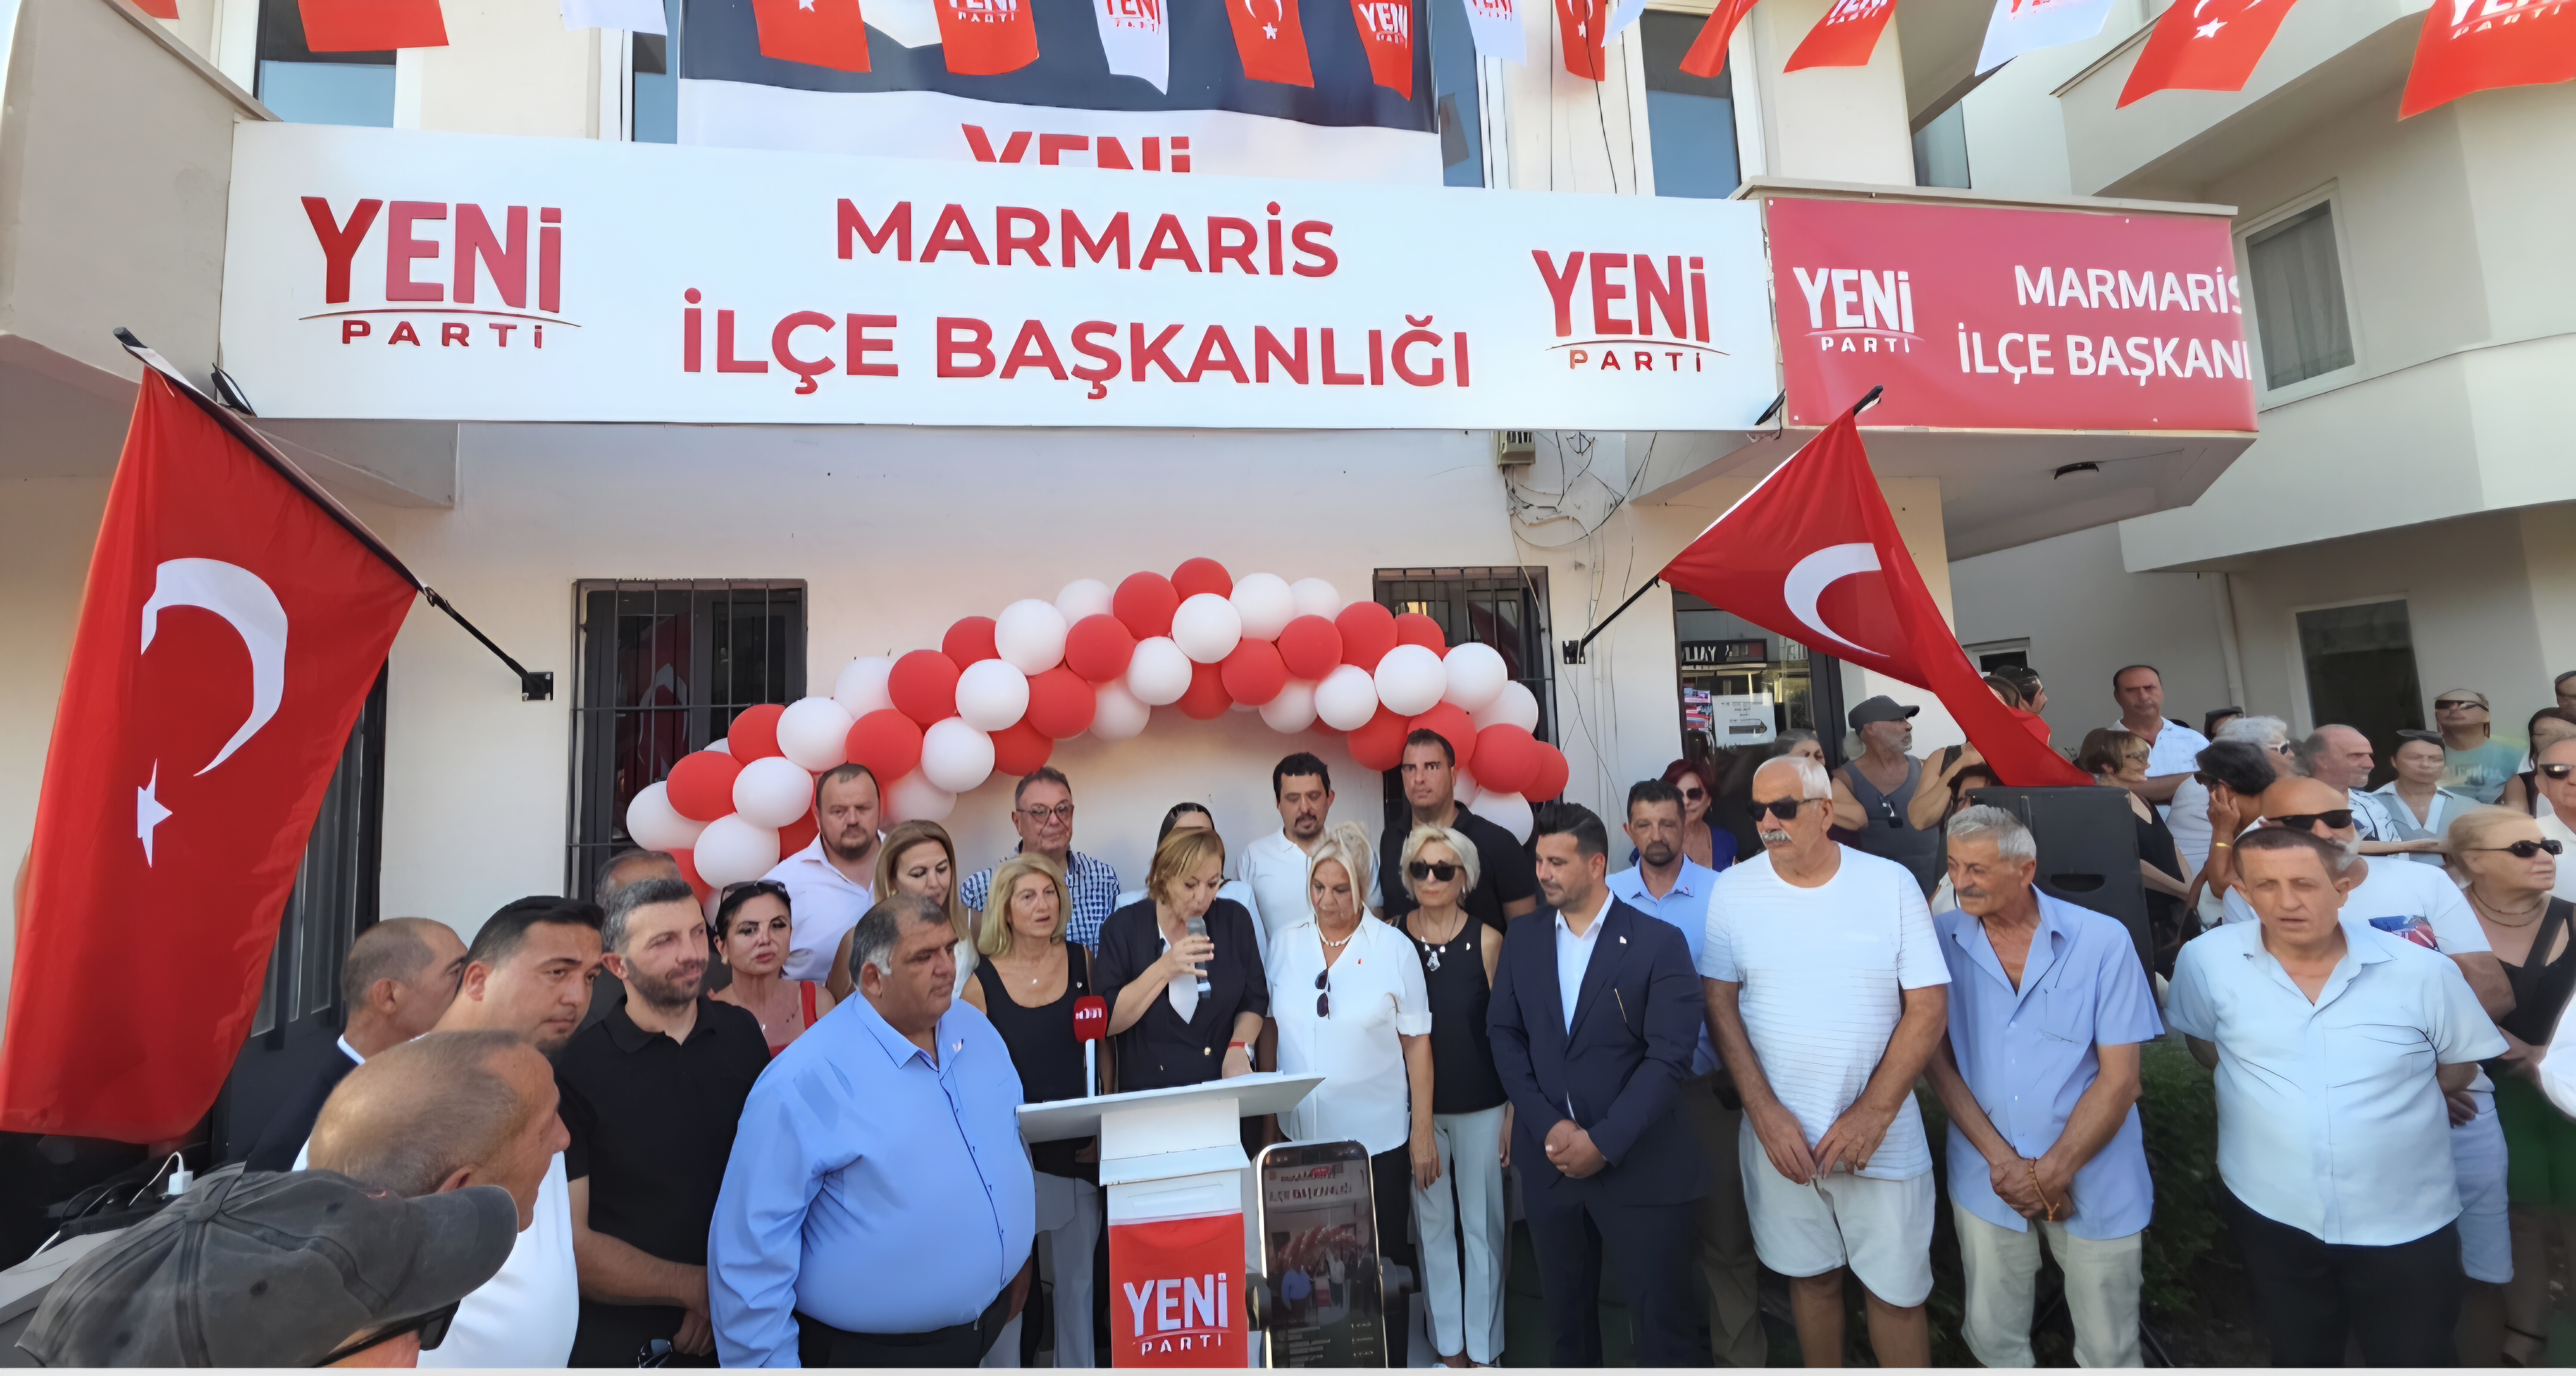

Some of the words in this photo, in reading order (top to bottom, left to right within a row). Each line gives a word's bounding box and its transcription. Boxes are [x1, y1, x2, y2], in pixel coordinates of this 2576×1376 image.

[301, 196, 562, 313] YENİ
[837, 199, 1338, 277] MARMARİS
[1531, 249, 1710, 343] YENİ
[684, 287, 899, 394] İLÇE
[936, 314, 1469, 399] BAŞKANLIĞI
[1958, 322, 2054, 385] İLÇE
[1123, 1272, 1228, 1337] YENİ
